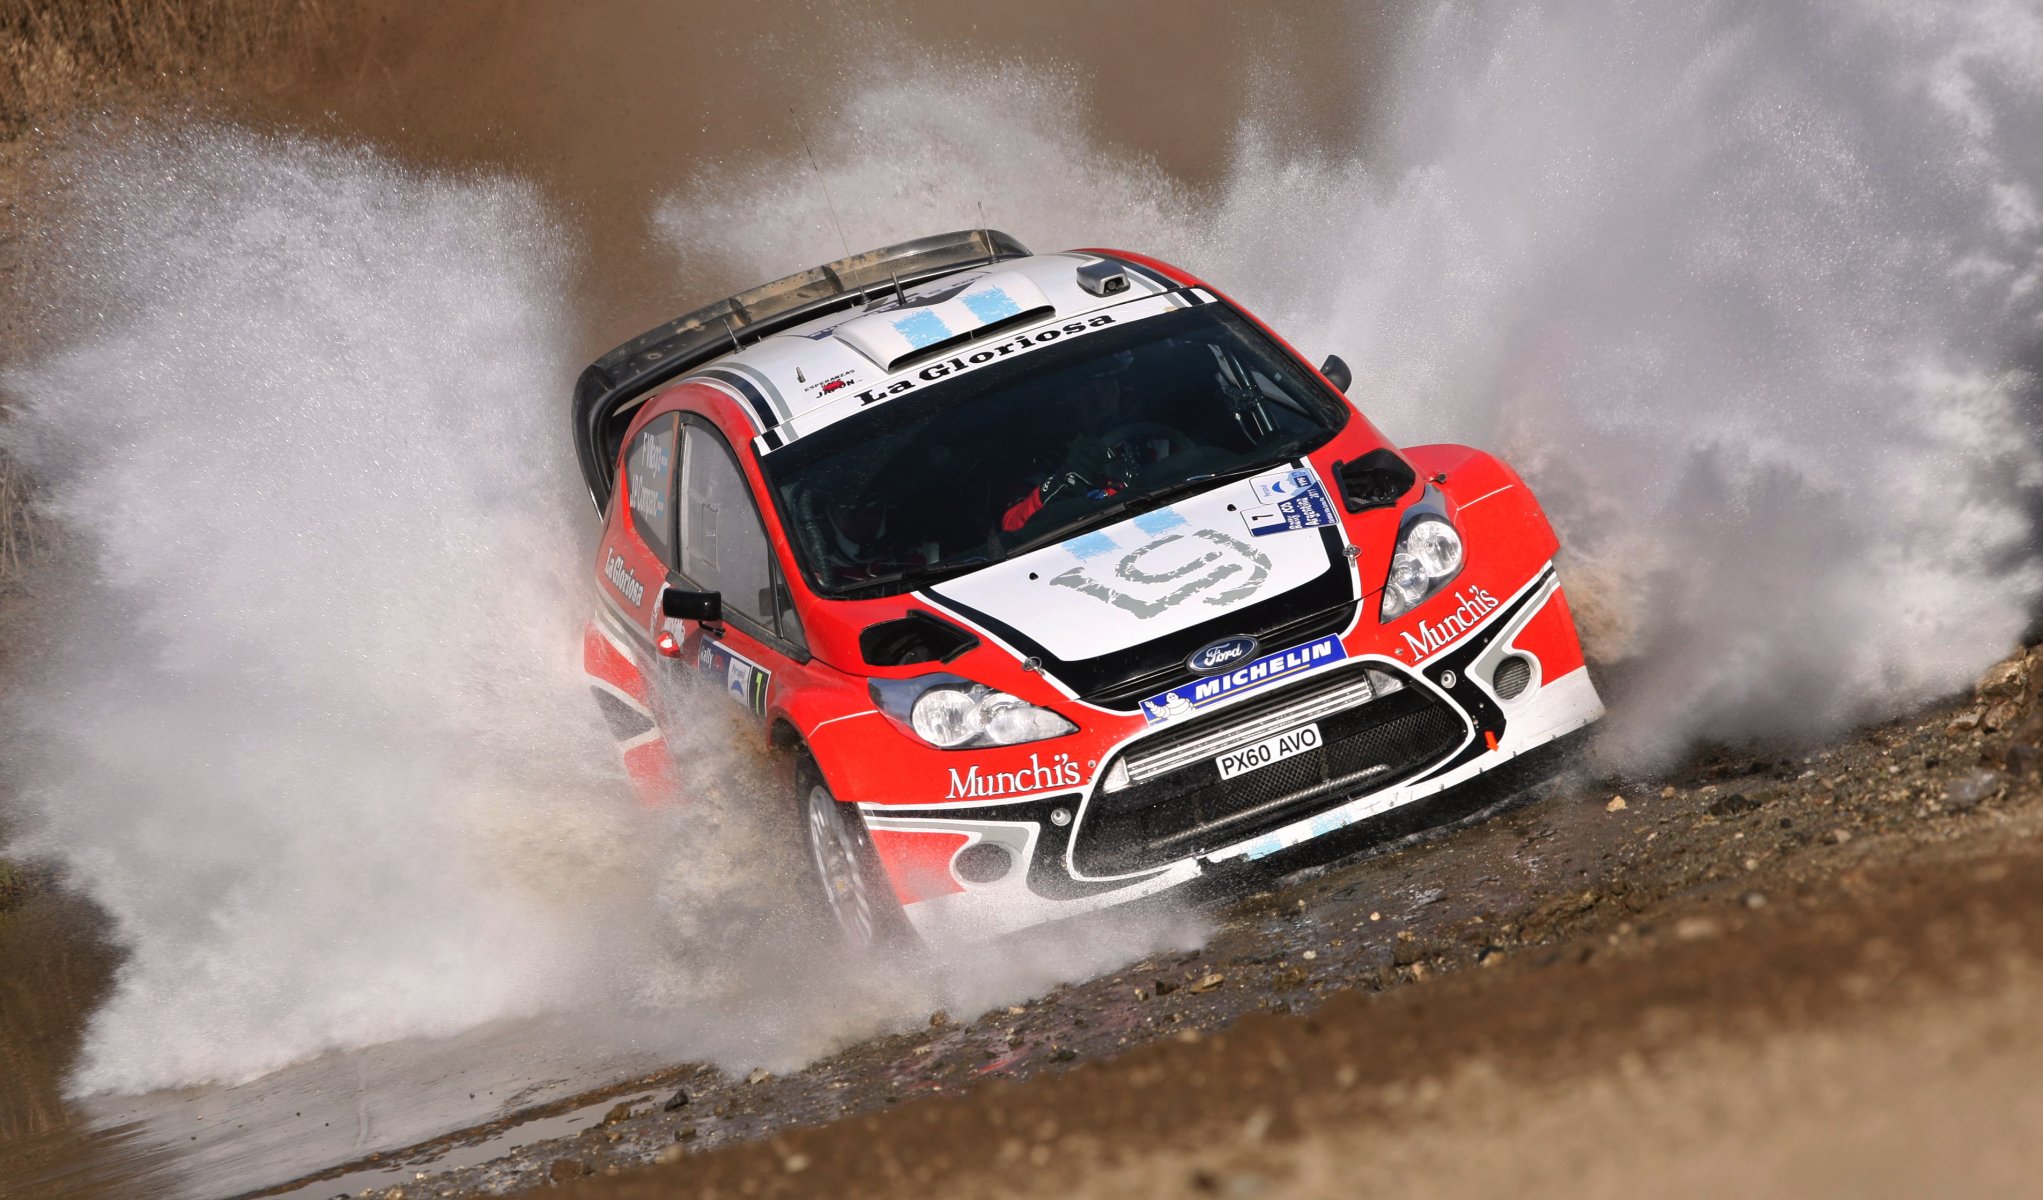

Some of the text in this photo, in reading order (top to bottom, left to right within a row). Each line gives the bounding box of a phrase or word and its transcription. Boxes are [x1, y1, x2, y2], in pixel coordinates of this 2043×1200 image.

[804, 368, 855, 392] ESPERANZAS
[855, 314, 1117, 408] La Gloriosa
[612, 555, 644, 608] Gloriosa
[1399, 584, 1500, 661] Munchi's
[1195, 639, 1332, 701] MICHELIN
[1203, 642, 1244, 668] Ford
[945, 753, 1081, 800] Munchi's
[1221, 729, 1318, 777] PX60 AVO
